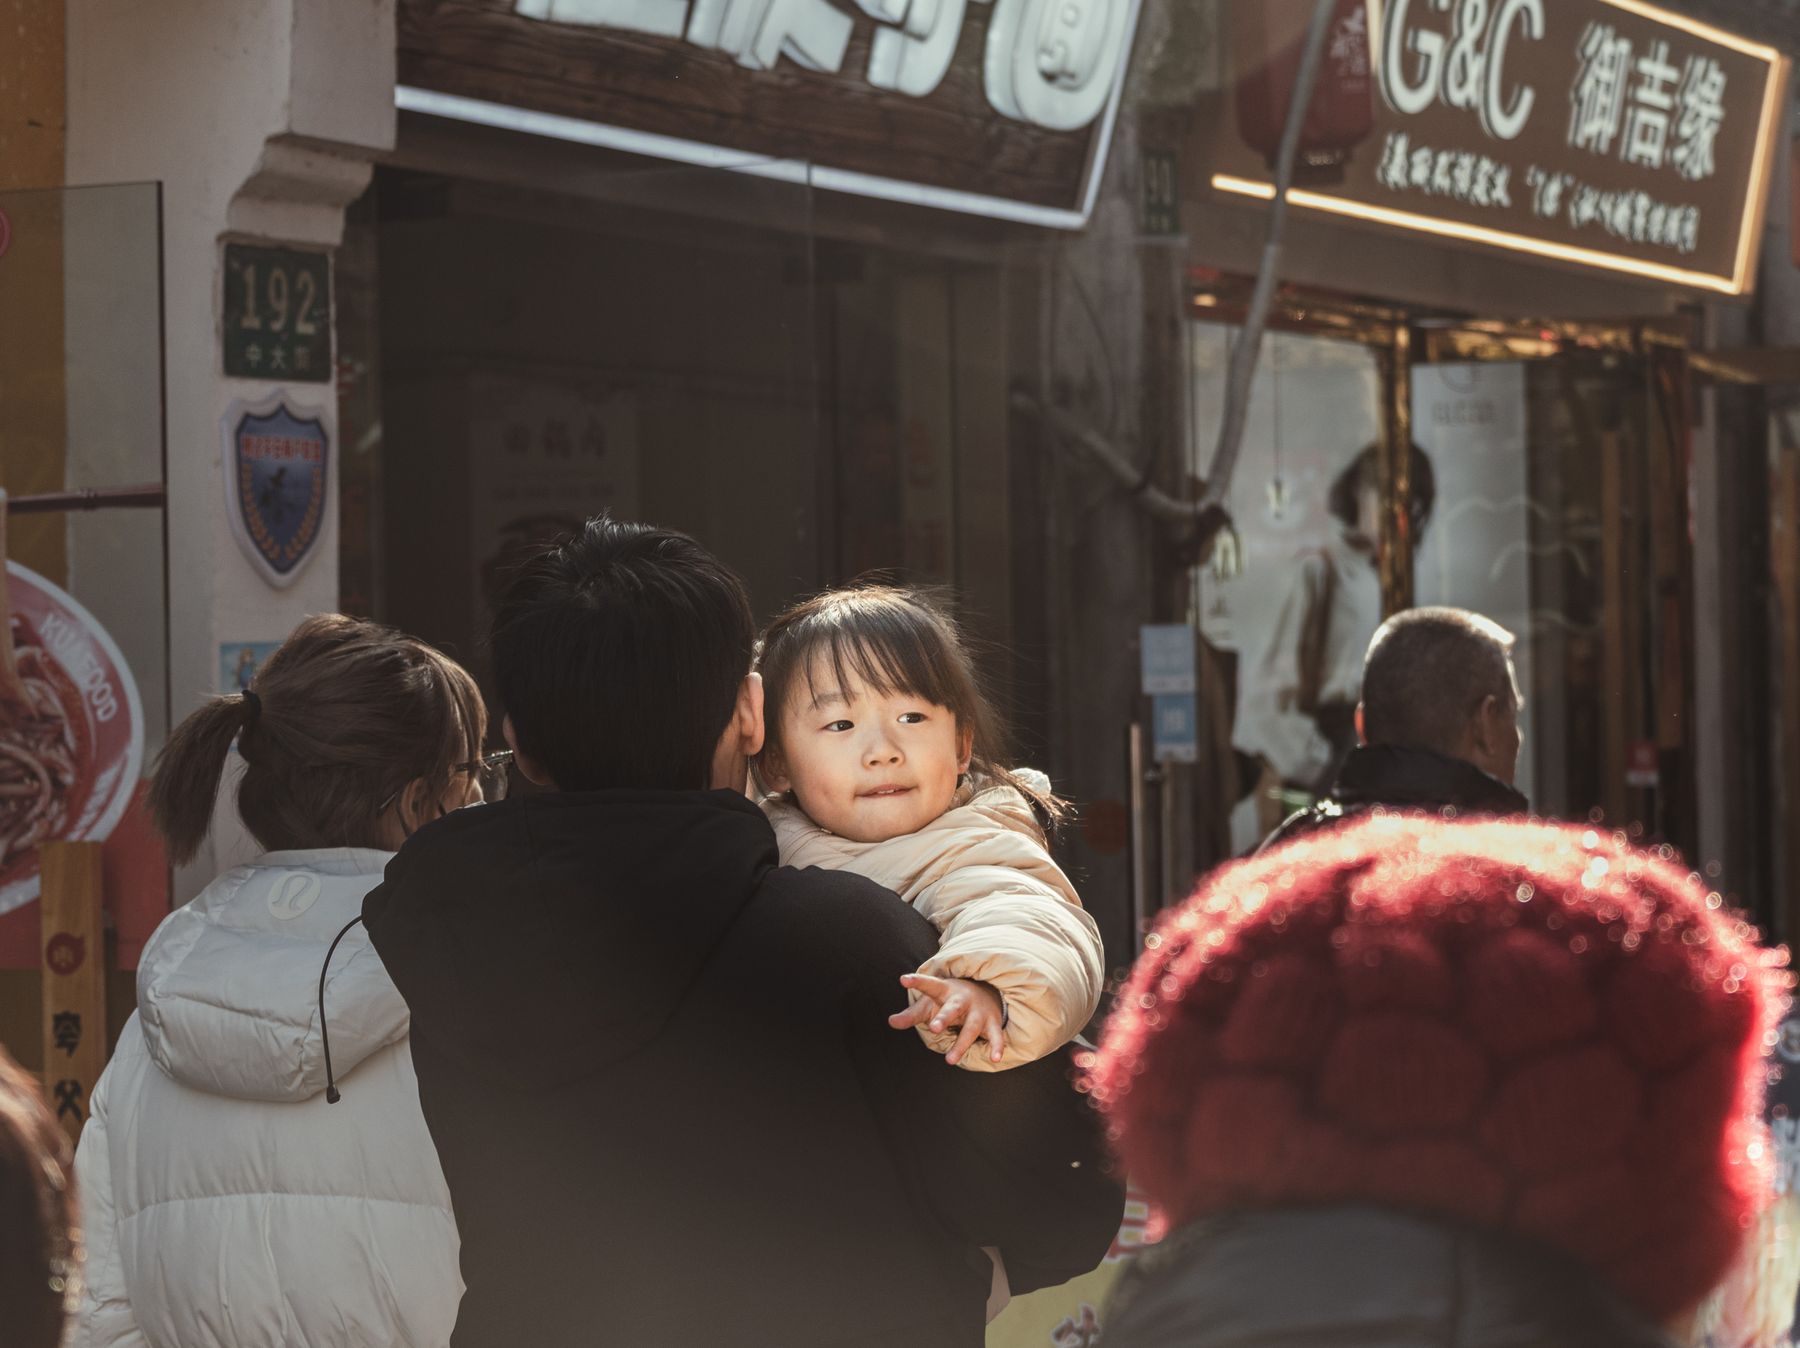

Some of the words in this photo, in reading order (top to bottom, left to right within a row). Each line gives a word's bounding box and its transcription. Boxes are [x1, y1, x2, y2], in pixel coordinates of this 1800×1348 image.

[1378, 0, 1545, 139] G&C
[1568, 20, 1728, 181] 御吉缘
[242, 264, 316, 335] 192
